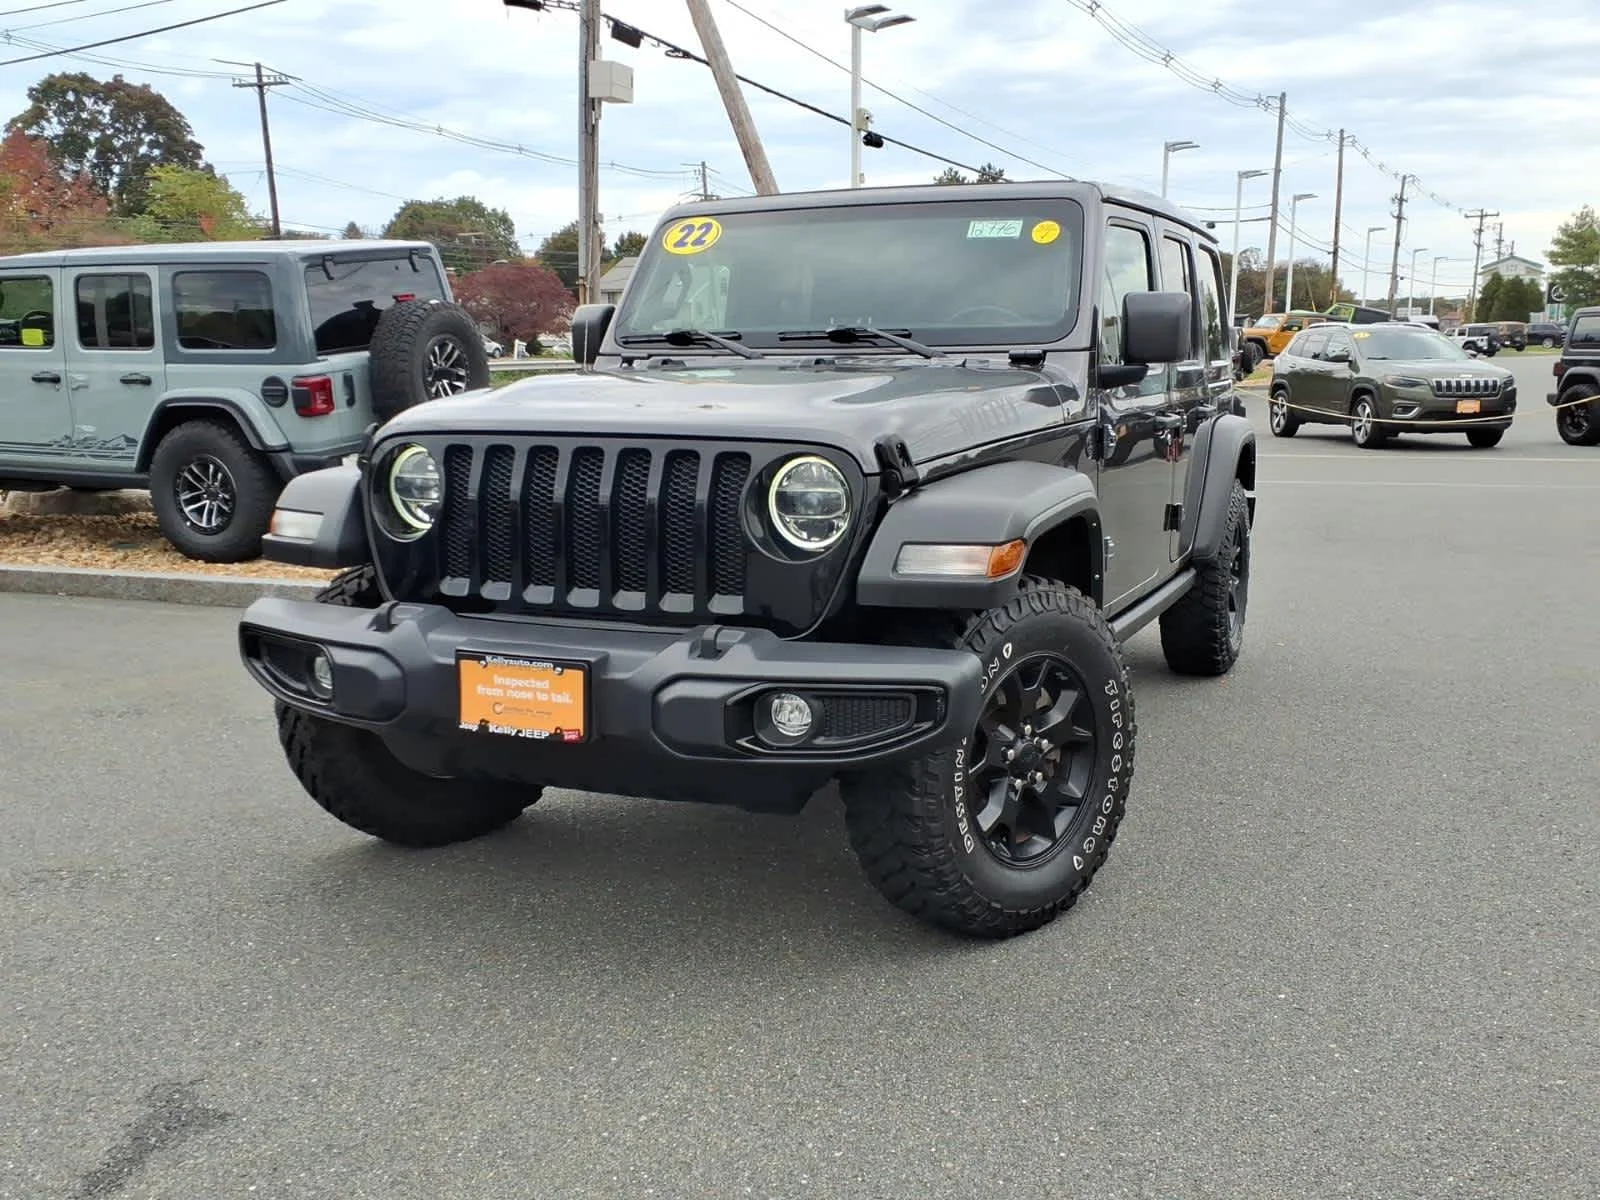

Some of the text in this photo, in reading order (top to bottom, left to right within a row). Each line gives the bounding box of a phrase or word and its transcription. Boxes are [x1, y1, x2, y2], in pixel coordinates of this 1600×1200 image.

[673, 222, 713, 248] 22
[485, 656, 554, 669] Kellyauto.com
[493, 674, 550, 690] Inspected
[476, 683, 505, 697] from
[506, 689, 534, 700] nose
[536, 690, 549, 702] to
[488, 723, 518, 737] Kelly
[518, 727, 550, 740] JEEP
